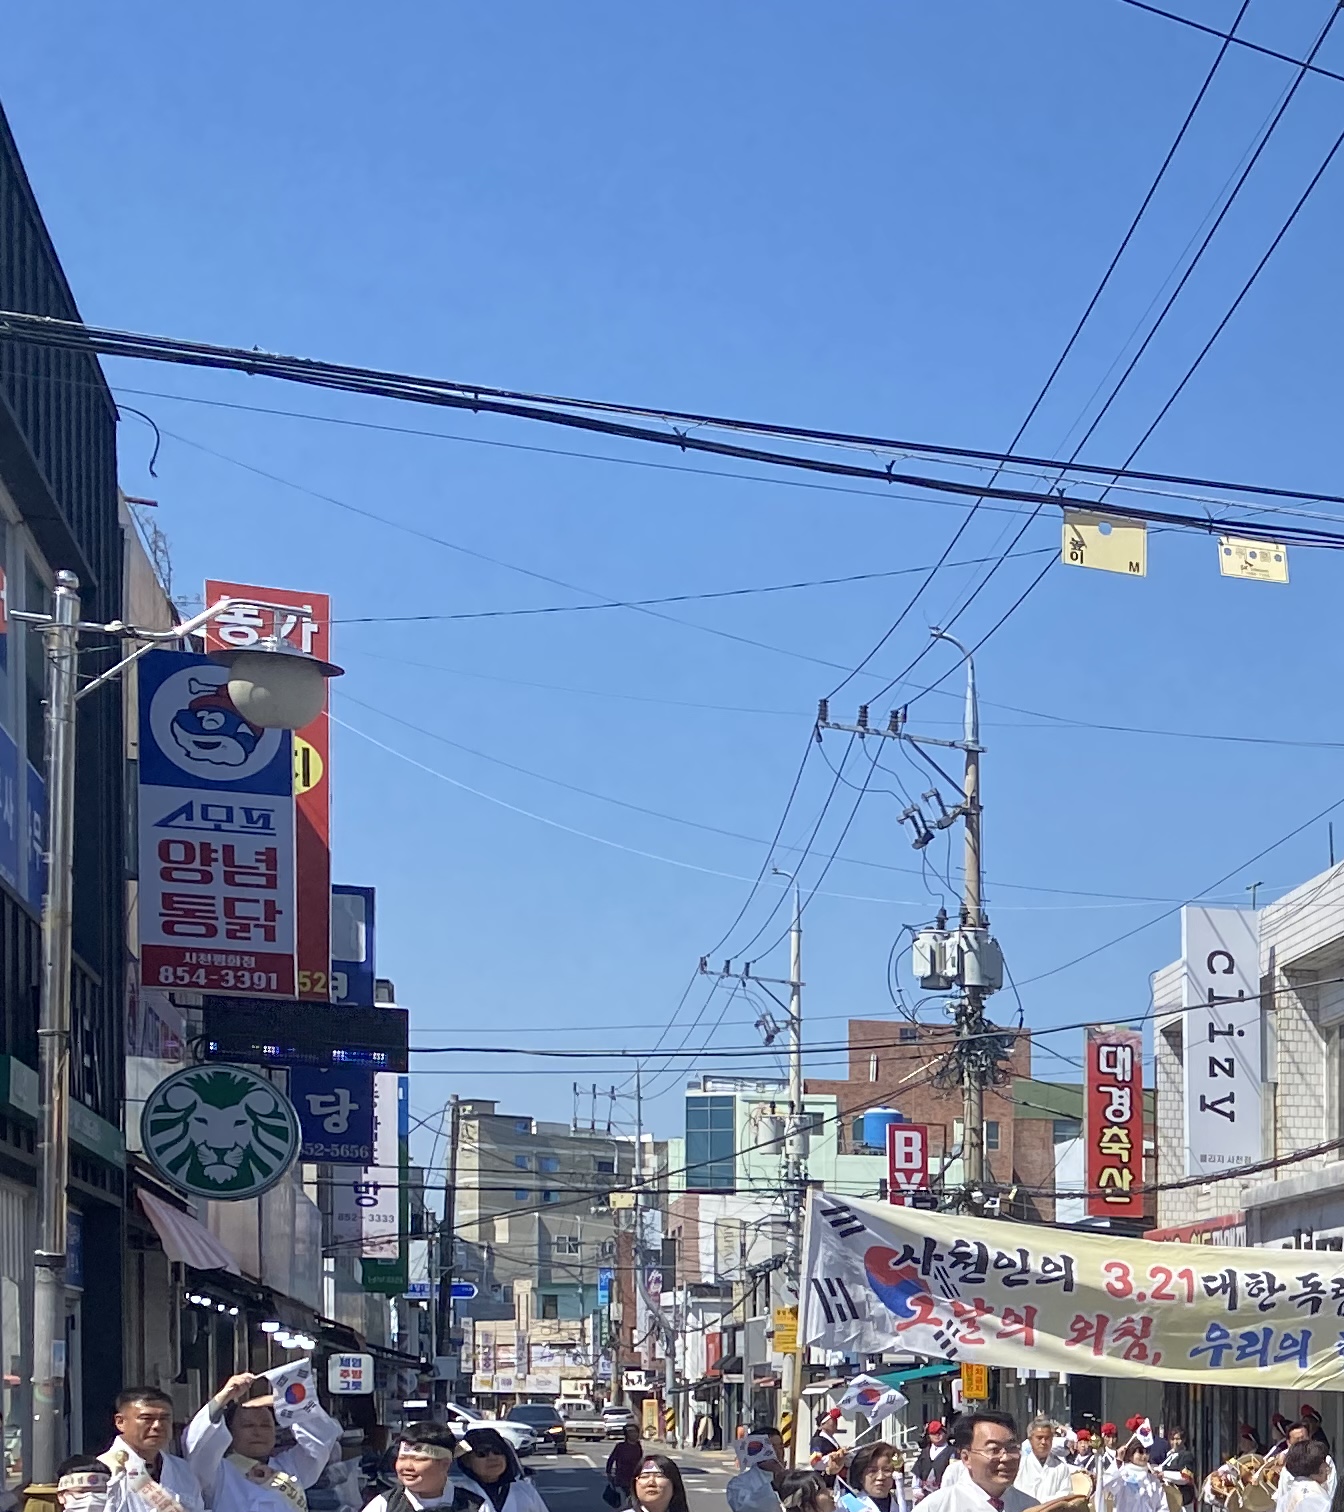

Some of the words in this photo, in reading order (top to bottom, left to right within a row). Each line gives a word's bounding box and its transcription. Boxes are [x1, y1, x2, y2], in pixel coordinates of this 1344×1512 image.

[158, 838, 278, 890] 양념
[158, 892, 284, 943] 통닭
[159, 965, 278, 990] 854-3391
[1099, 1044, 1132, 1204] 대경축산
[893, 1236, 1074, 1292] 사천인의
[896, 1298, 1037, 1347] 그날의
[1065, 1313, 1161, 1366] 외침,
[1189, 1322, 1312, 1369] 우리의
